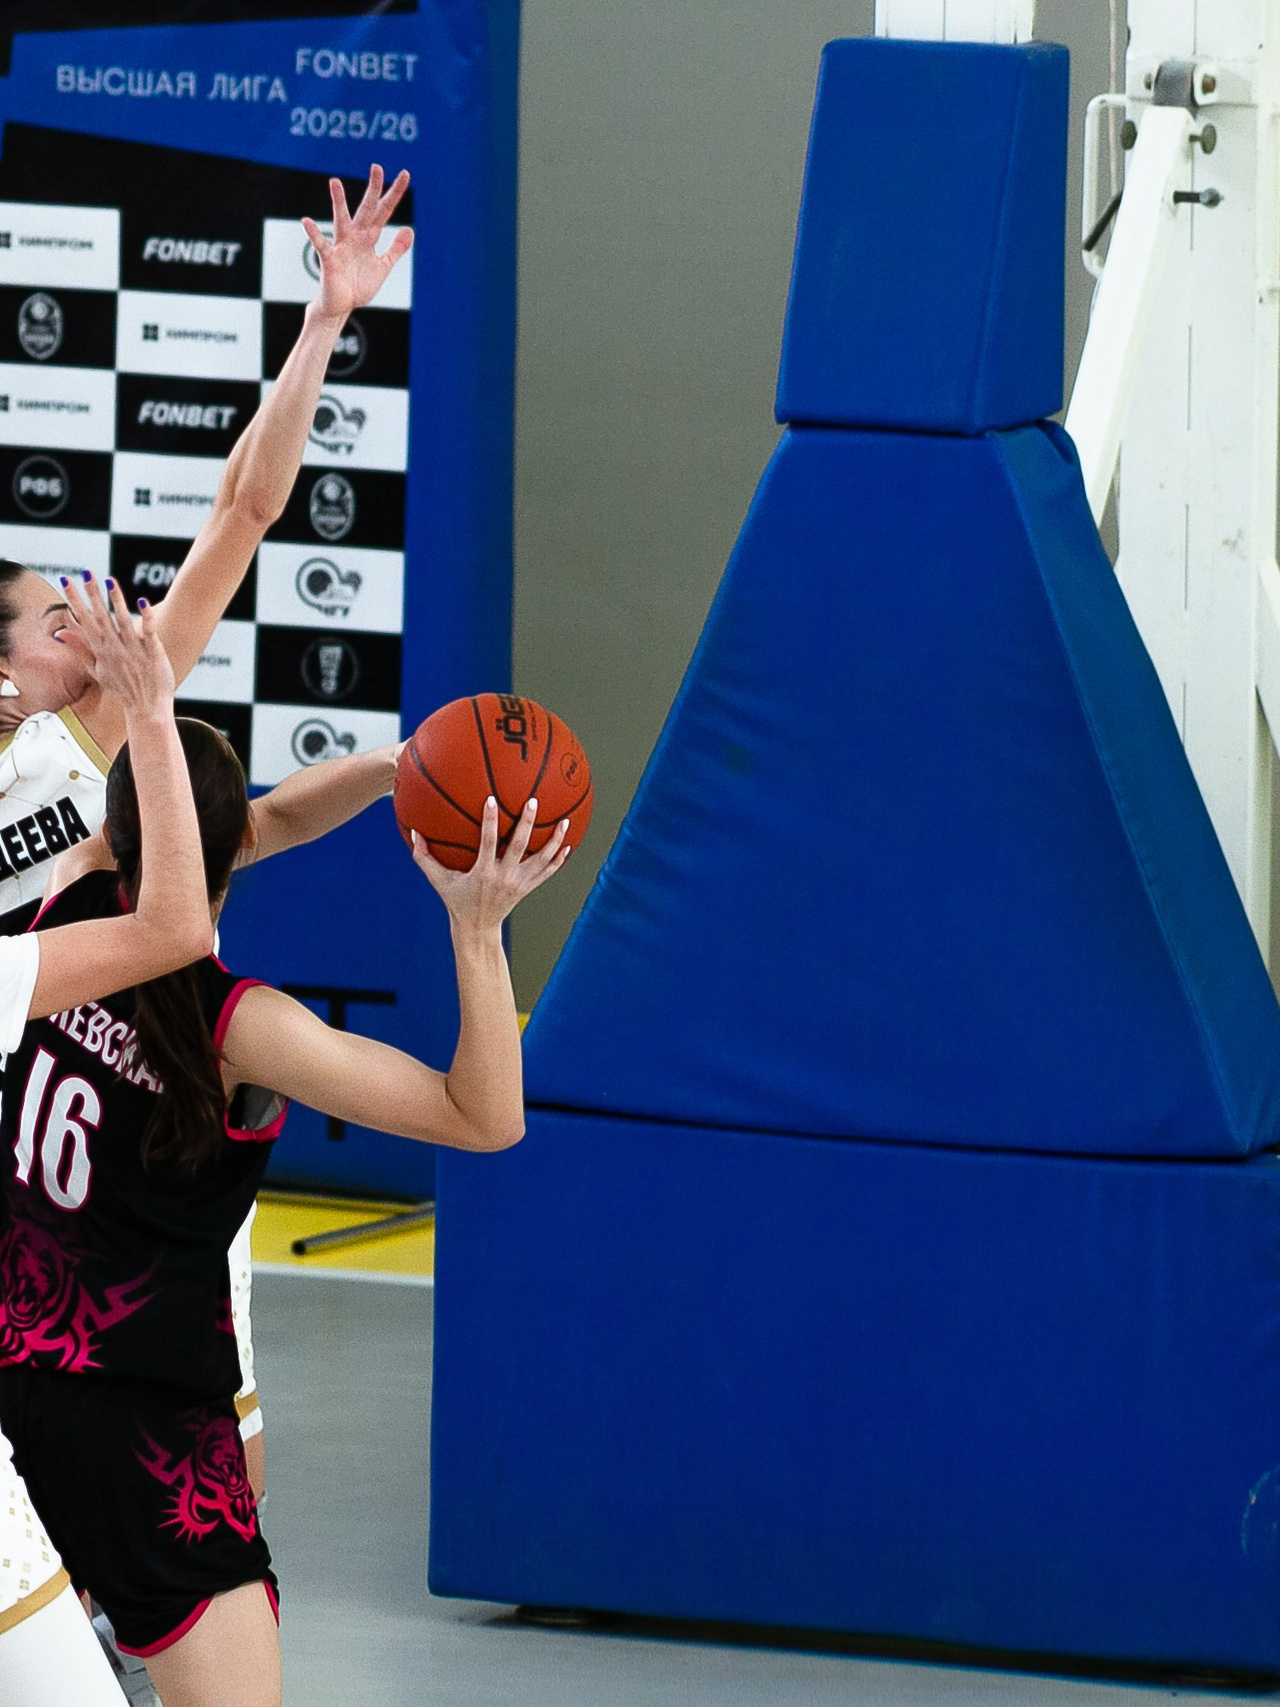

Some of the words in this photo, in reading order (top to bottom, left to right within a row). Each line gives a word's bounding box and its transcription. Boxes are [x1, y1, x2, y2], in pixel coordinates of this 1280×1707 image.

[295, 48, 417, 81] FONBET
[56, 64, 196, 98] ВЫСШАЯ
[207, 73, 288, 102] ЛИГА
[289, 107, 417, 142] 2025/26
[142, 237, 242, 266] FONBET
[137, 400, 237, 429] FONBET
[14, 1045, 101, 1211] 16
